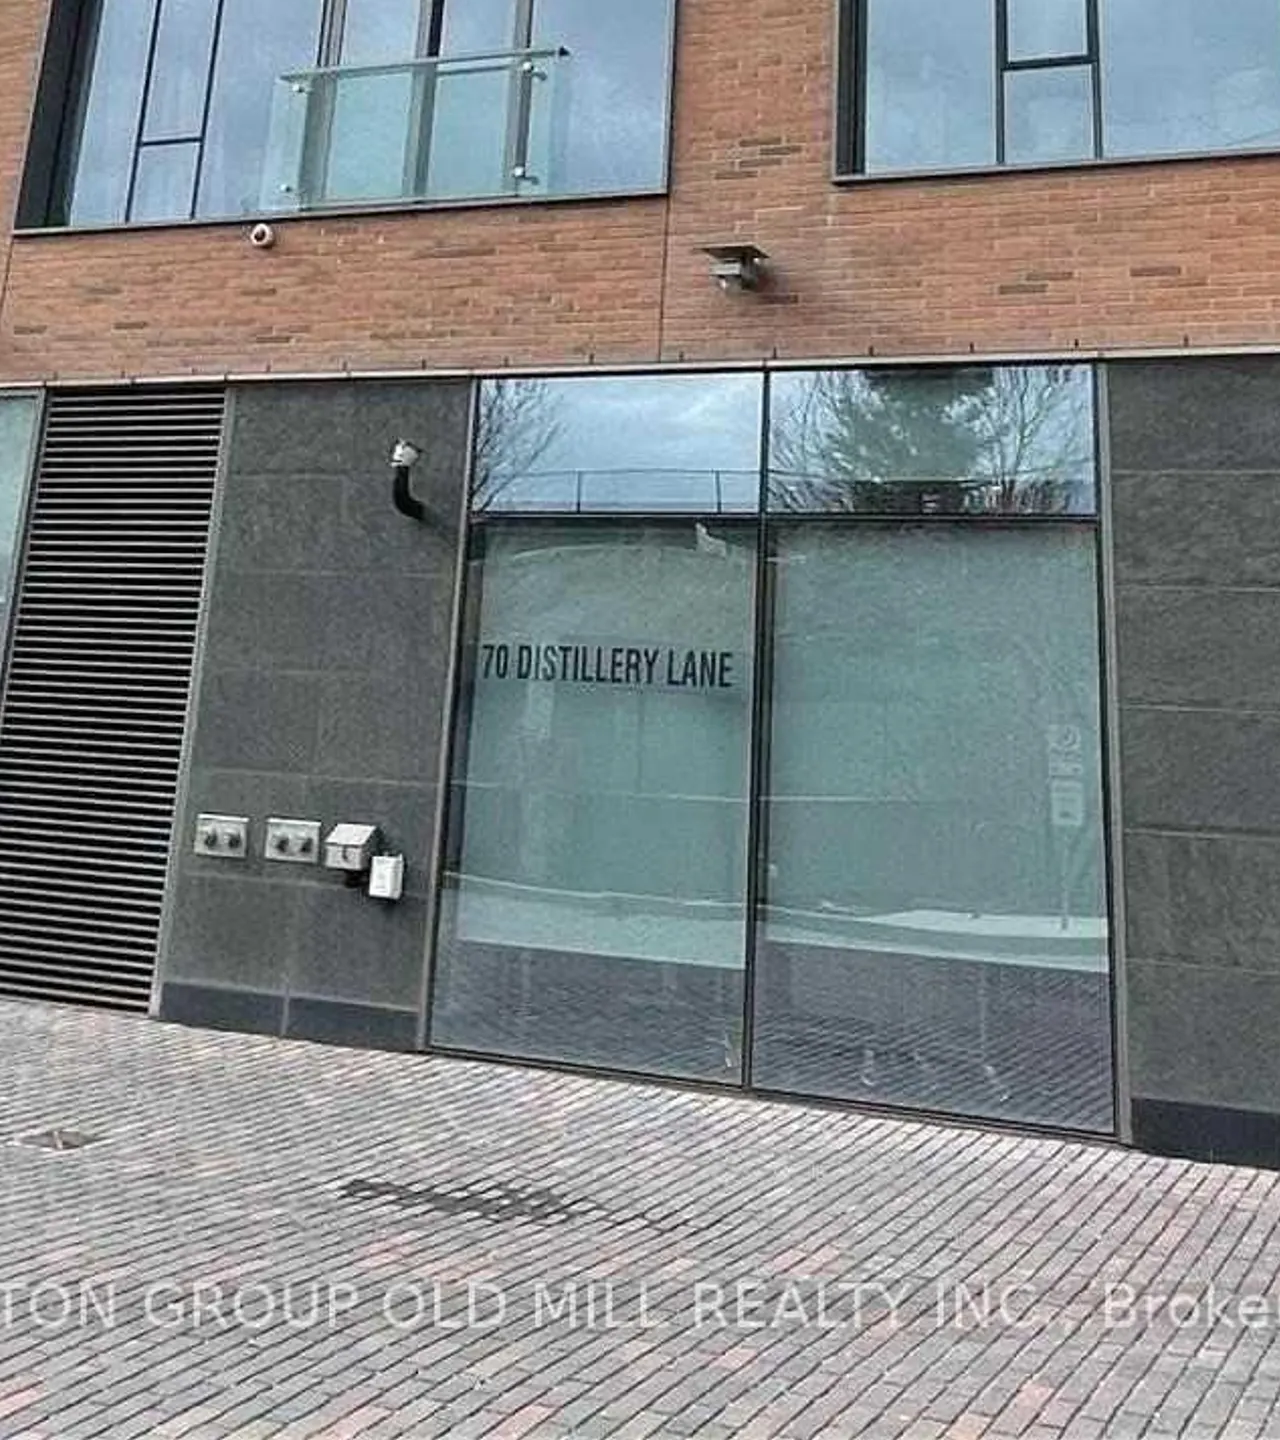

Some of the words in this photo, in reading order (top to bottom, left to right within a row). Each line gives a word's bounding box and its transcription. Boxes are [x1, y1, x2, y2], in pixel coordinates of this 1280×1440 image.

[482, 644, 510, 679] 70
[517, 644, 660, 685] DISTILLERY
[667, 649, 734, 688] LANE
